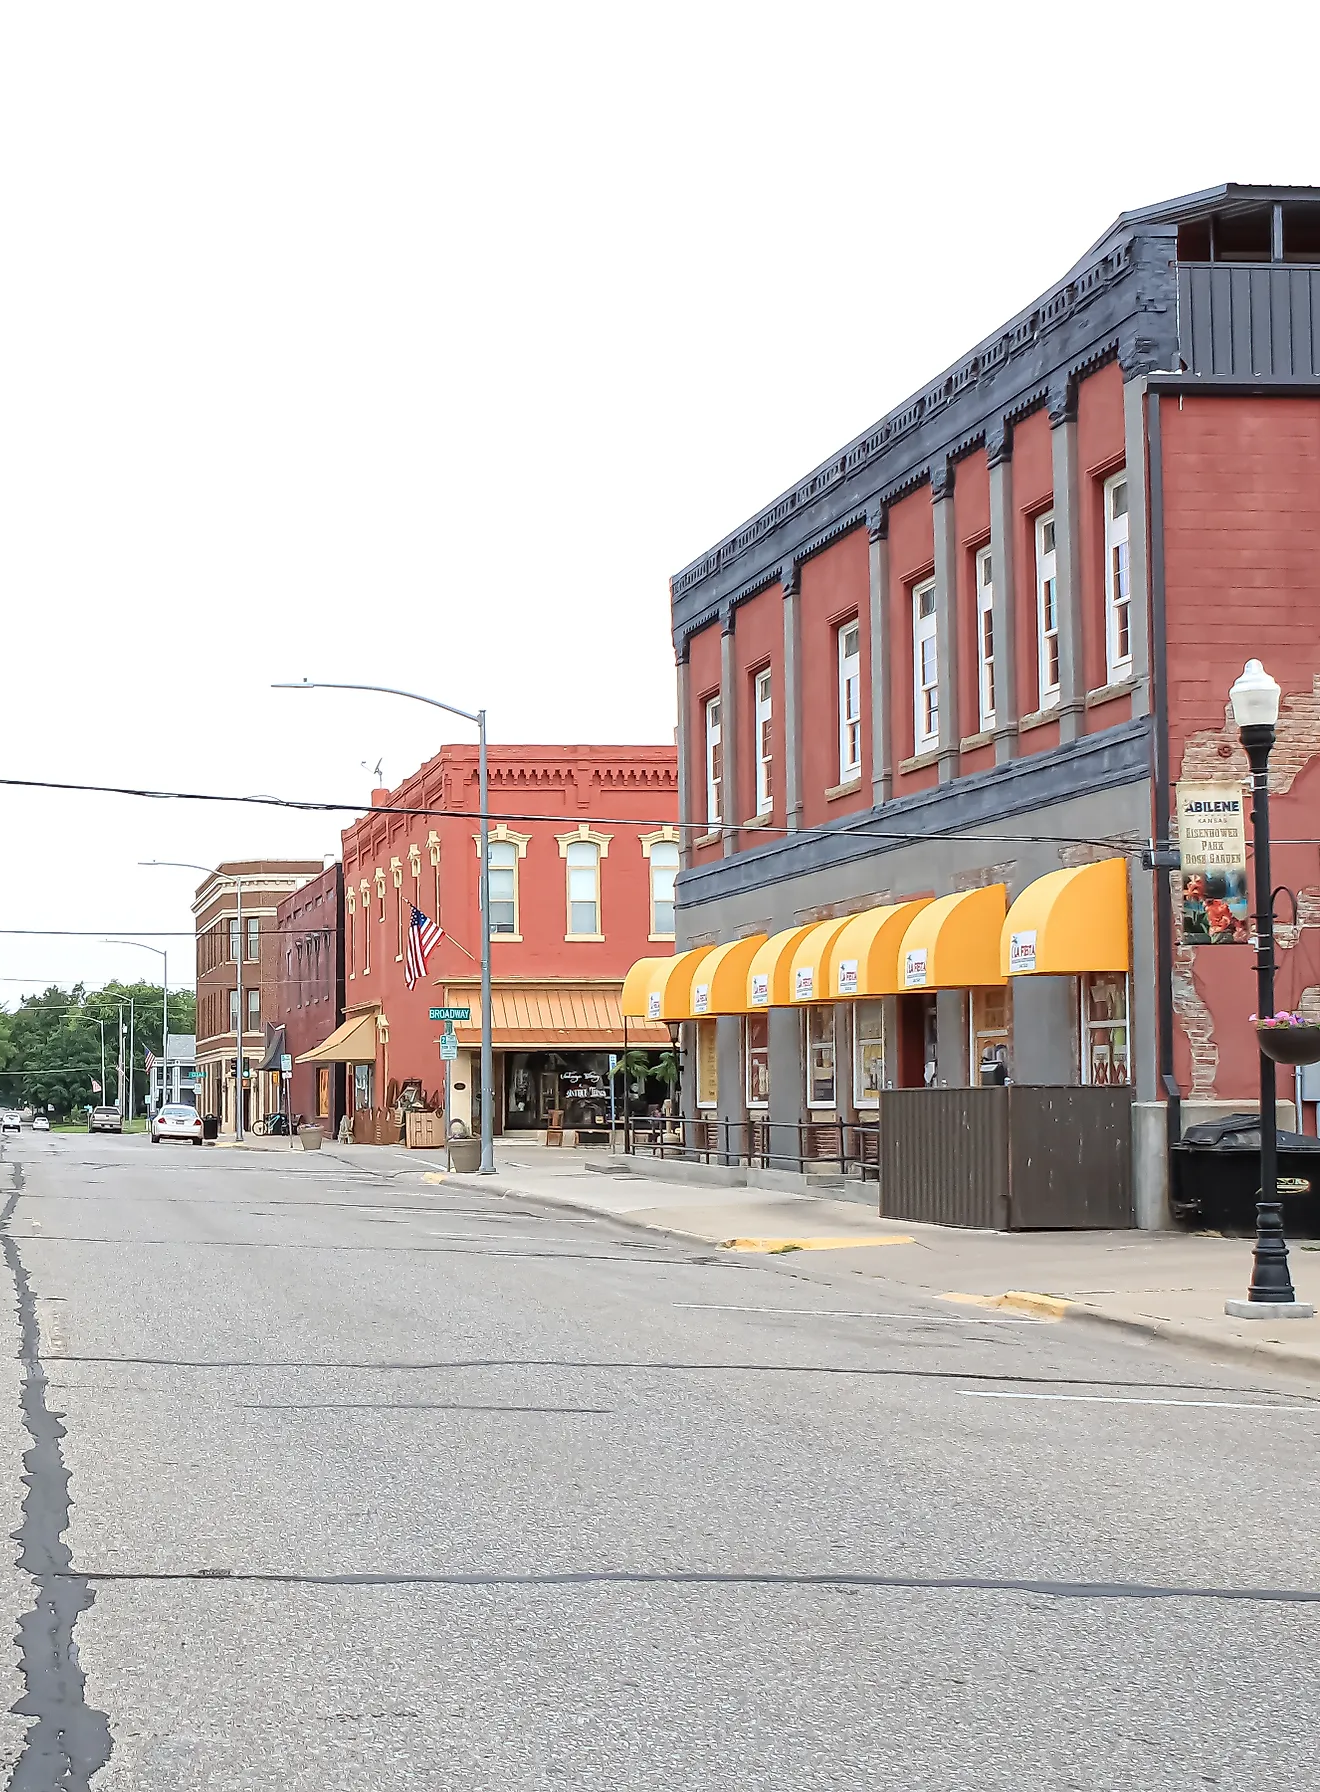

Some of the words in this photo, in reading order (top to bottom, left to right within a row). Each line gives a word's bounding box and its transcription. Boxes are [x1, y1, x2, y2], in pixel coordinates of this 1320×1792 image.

[1185, 801, 1240, 813] ABILENE
[1201, 840, 1224, 851] PARK
[430, 1010, 469, 1019] BROADWAY
